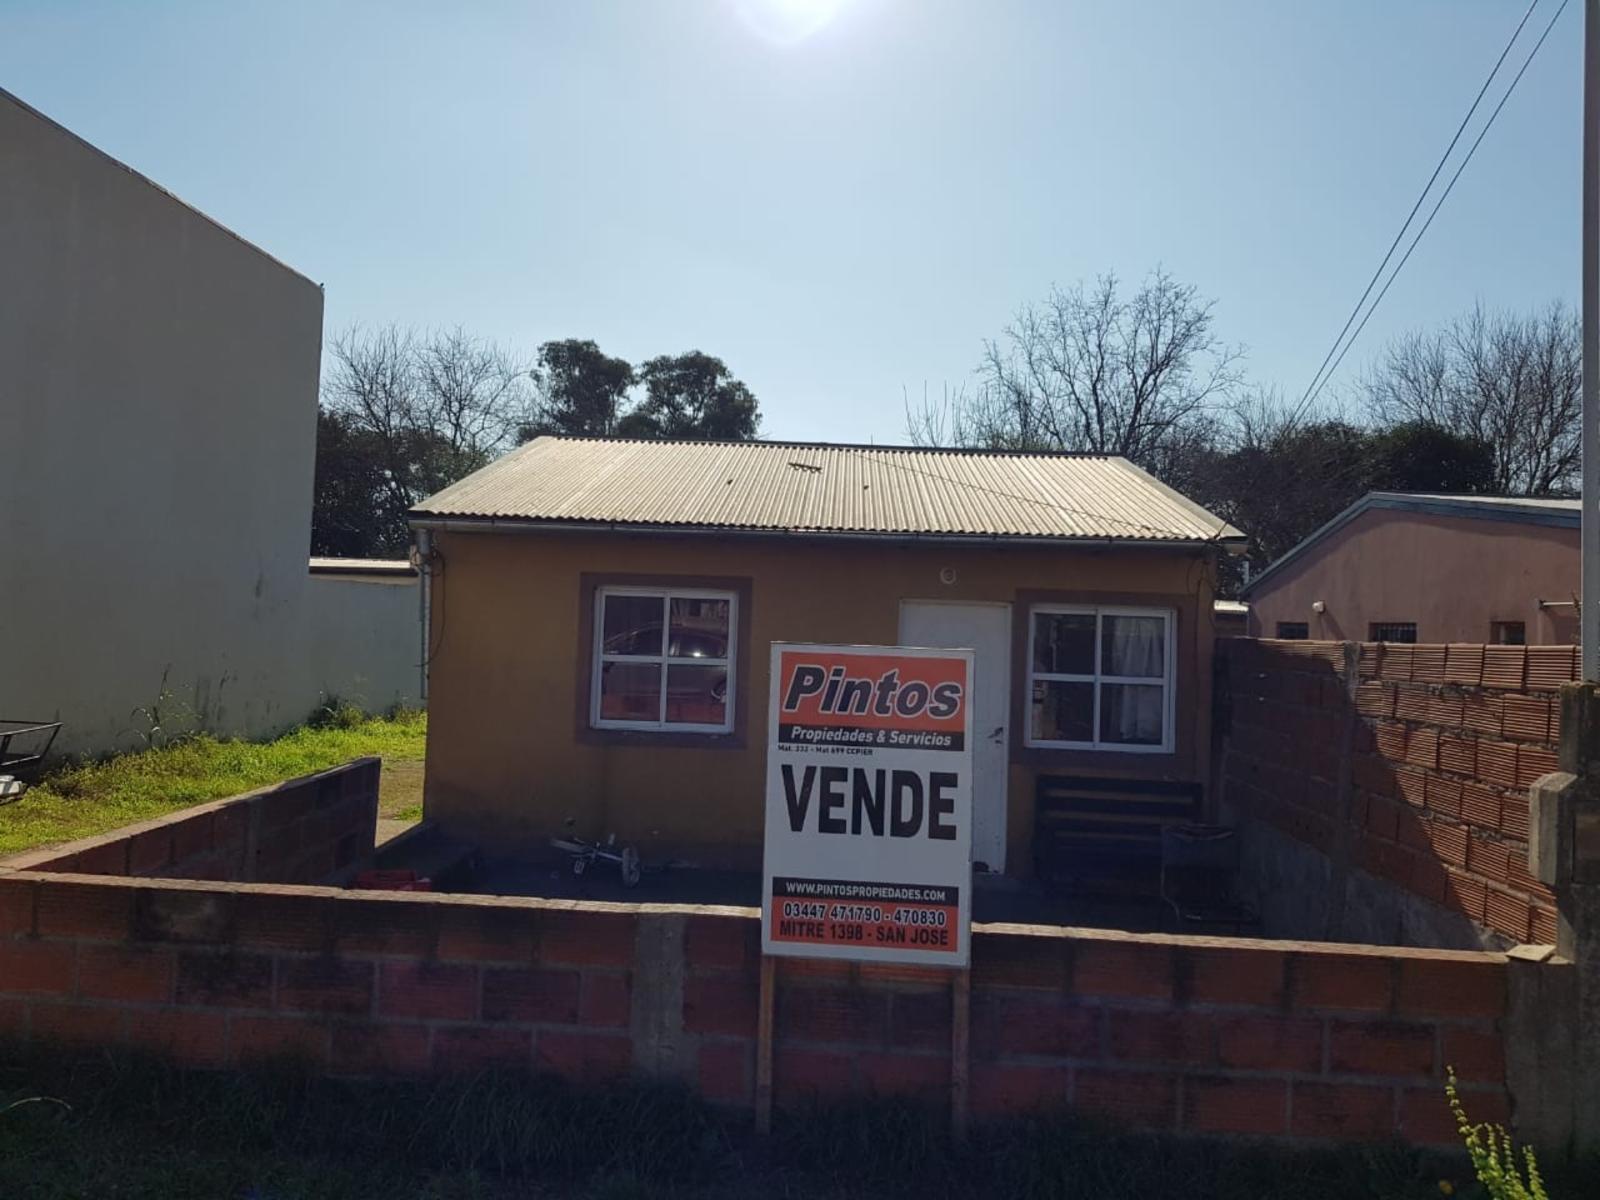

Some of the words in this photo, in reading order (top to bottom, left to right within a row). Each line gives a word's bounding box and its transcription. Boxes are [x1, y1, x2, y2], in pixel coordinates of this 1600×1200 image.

[783, 665, 961, 718] Pintos
[791, 726, 873, 742] Propiedades
[876, 731, 885, 743] &
[890, 731, 951, 746] Servicios
[781, 764, 958, 840] VENDE
[786, 882, 945, 900] WWW.PINTOSPROPIEDADES.COM
[784, 902, 826, 919] 03447
[830, 905, 881, 922] 471790
[894, 908, 945, 926] 470830
[780, 921, 824, 938] MITRE
[830, 923, 863, 940] 1398
[876, 926, 905, 943] SAN
[911, 928, 948, 945] JOSE
